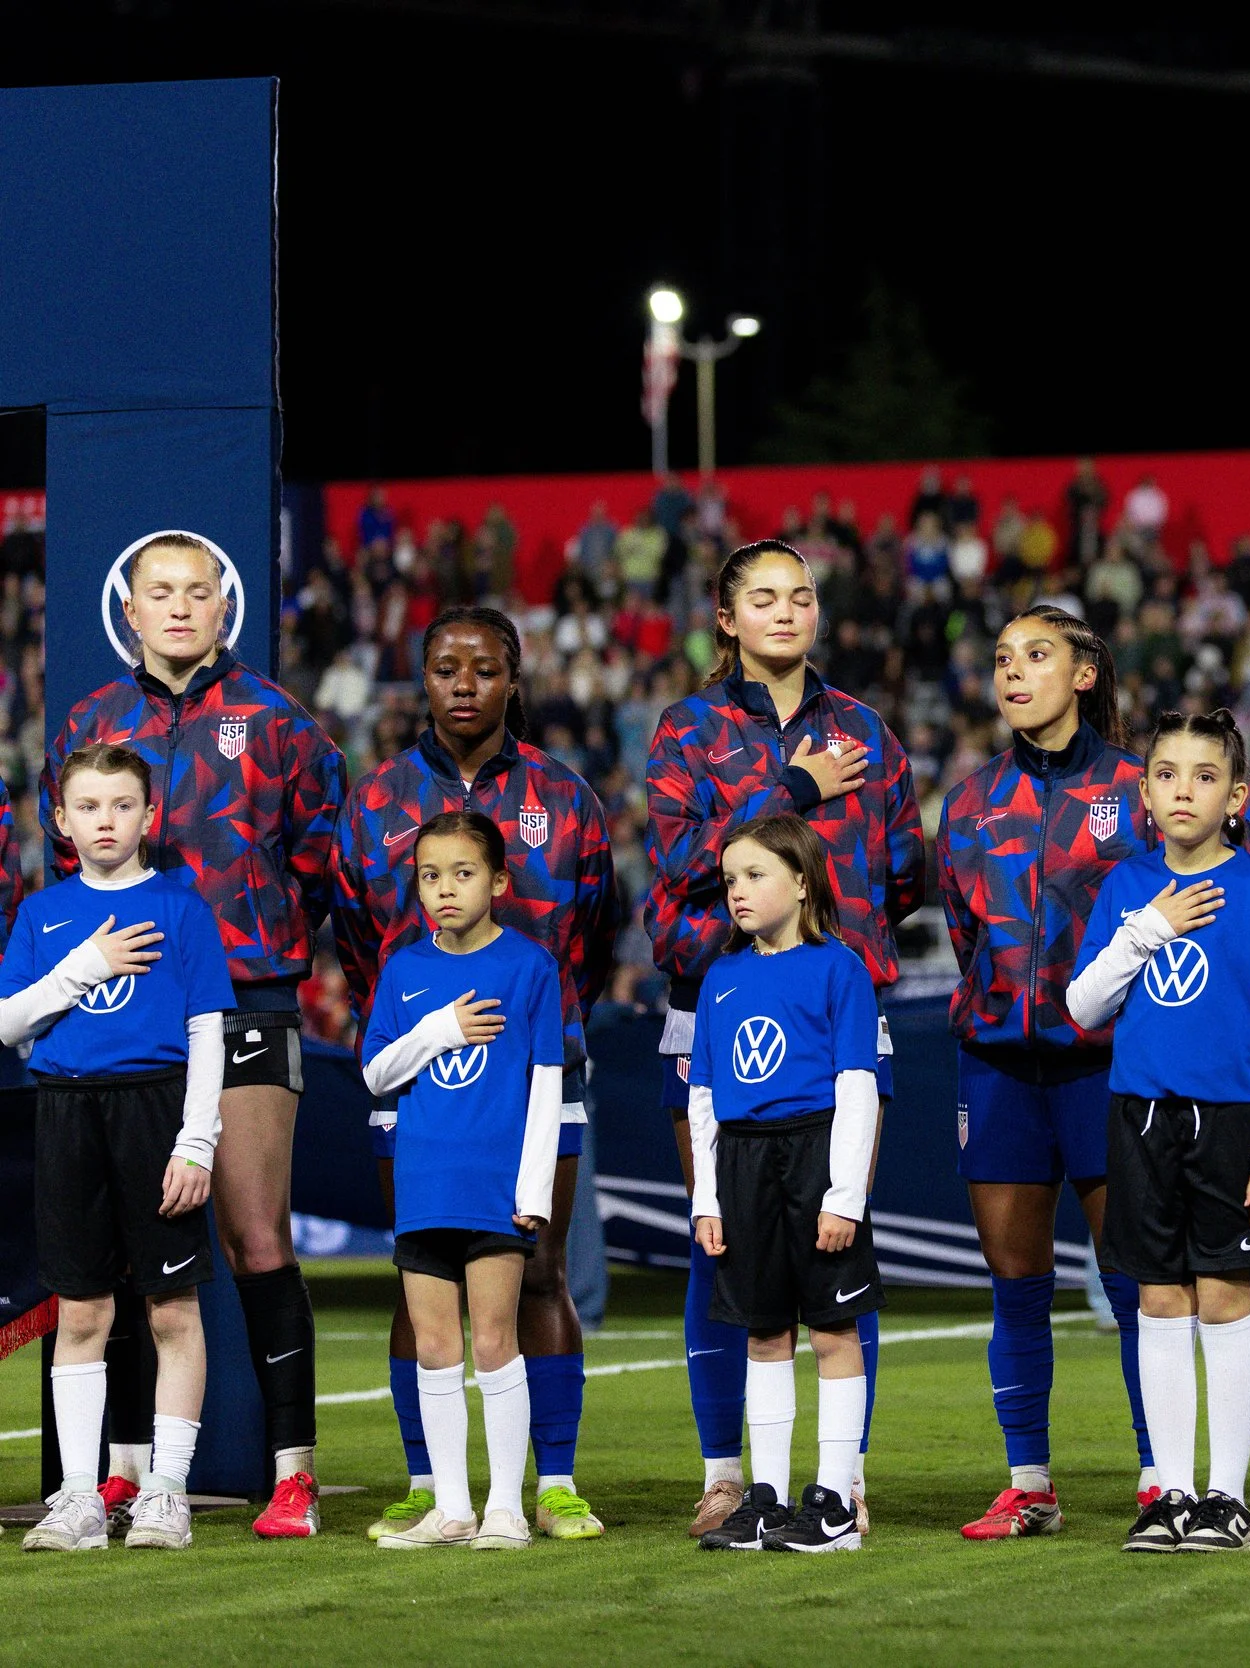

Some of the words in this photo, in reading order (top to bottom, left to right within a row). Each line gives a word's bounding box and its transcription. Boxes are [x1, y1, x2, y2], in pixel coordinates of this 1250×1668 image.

[220, 724, 246, 740] USA
[521, 813, 547, 830] USA
[1091, 805, 1119, 821] USA
[1146, 939, 1207, 1004] VW
[735, 1017, 785, 1080] VW
